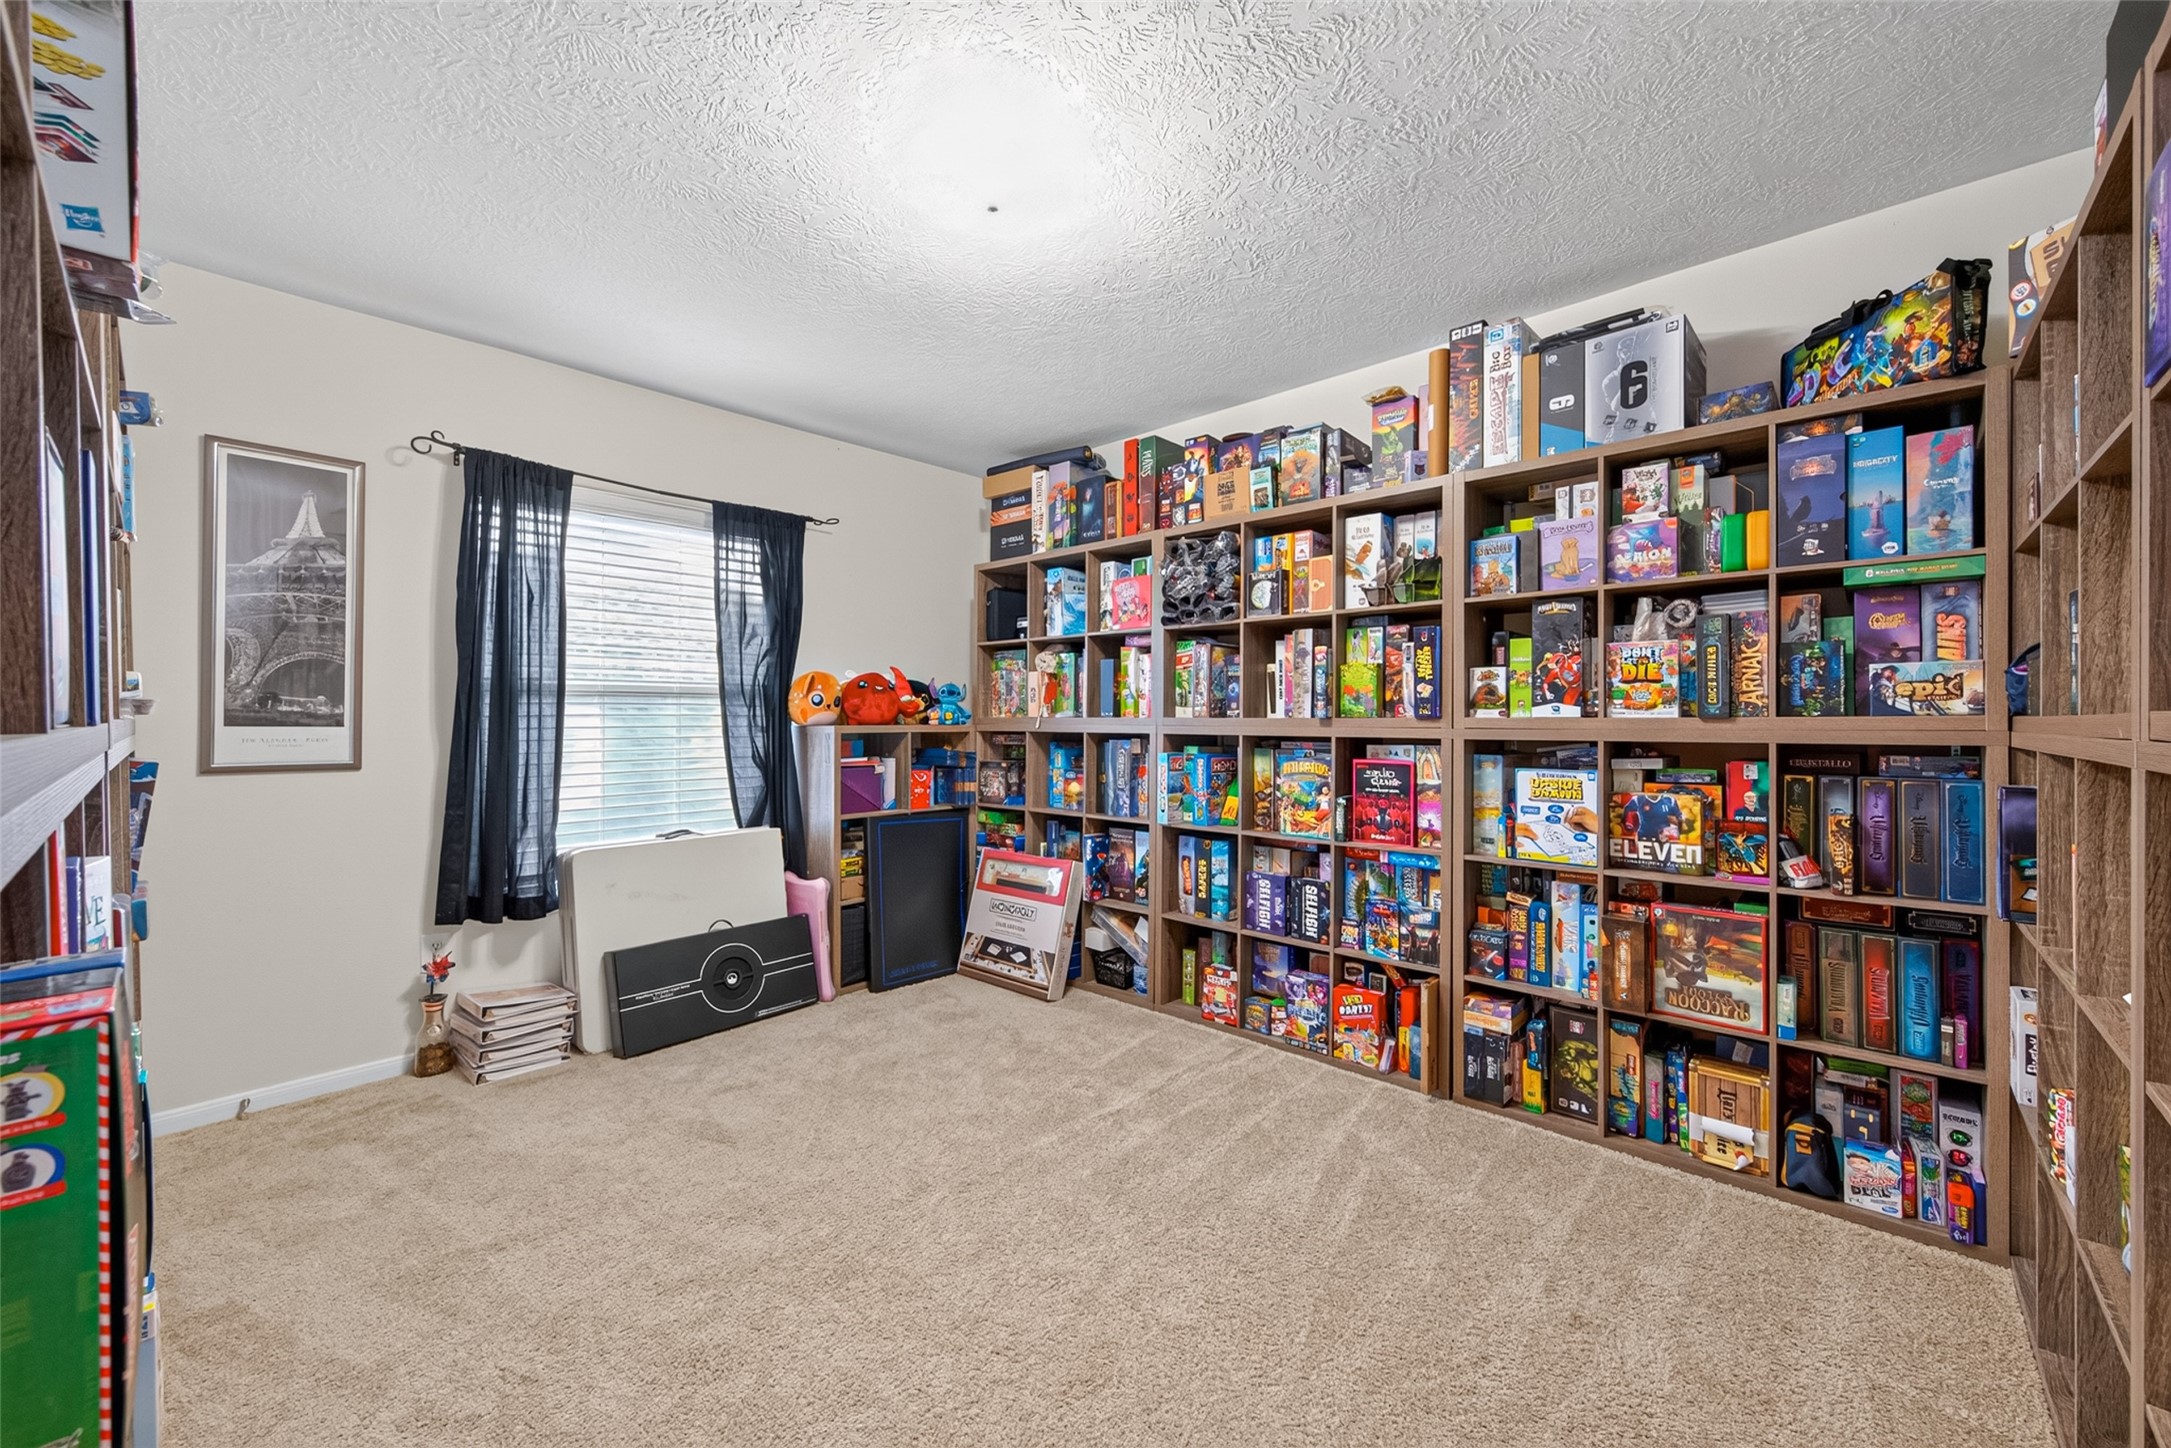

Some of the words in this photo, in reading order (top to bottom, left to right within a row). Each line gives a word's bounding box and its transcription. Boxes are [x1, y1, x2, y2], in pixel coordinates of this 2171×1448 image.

[1619, 360, 1649, 410] 6
[1620, 662, 1664, 684] DIE
[1739, 638, 1763, 706] ARNAK
[1789, 758, 1852, 769] CRYSTALLO
[1609, 838, 1703, 865] ELEVEN
[1667, 990, 1751, 1023] RACCOON
